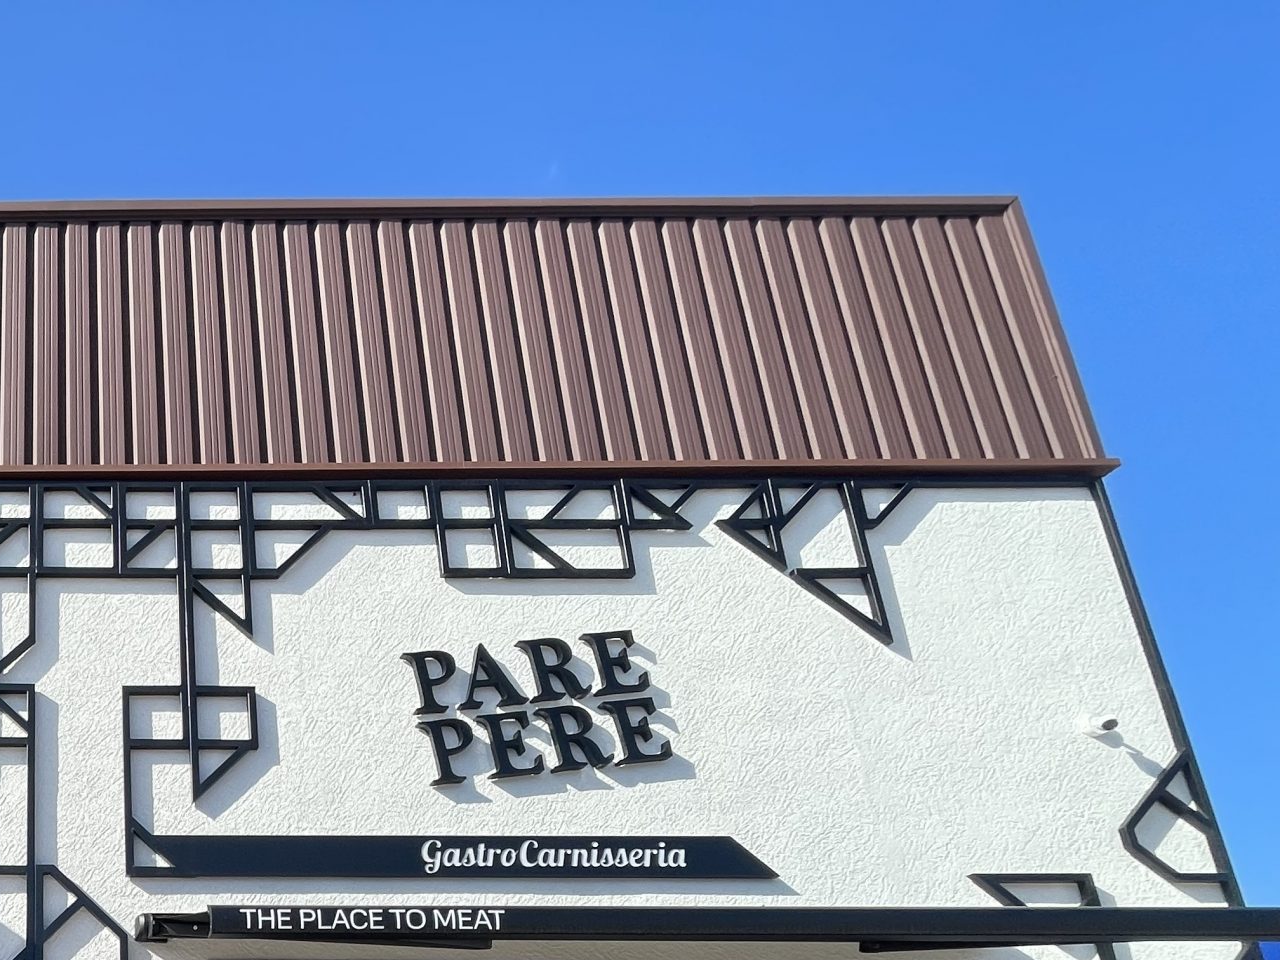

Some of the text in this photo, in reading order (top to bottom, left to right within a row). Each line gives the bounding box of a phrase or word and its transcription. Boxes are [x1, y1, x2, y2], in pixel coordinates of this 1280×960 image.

[400, 629, 650, 716] PARE
[416, 697, 673, 787] PERE
[239, 909, 505, 931] THE PLACE TO MEAT
